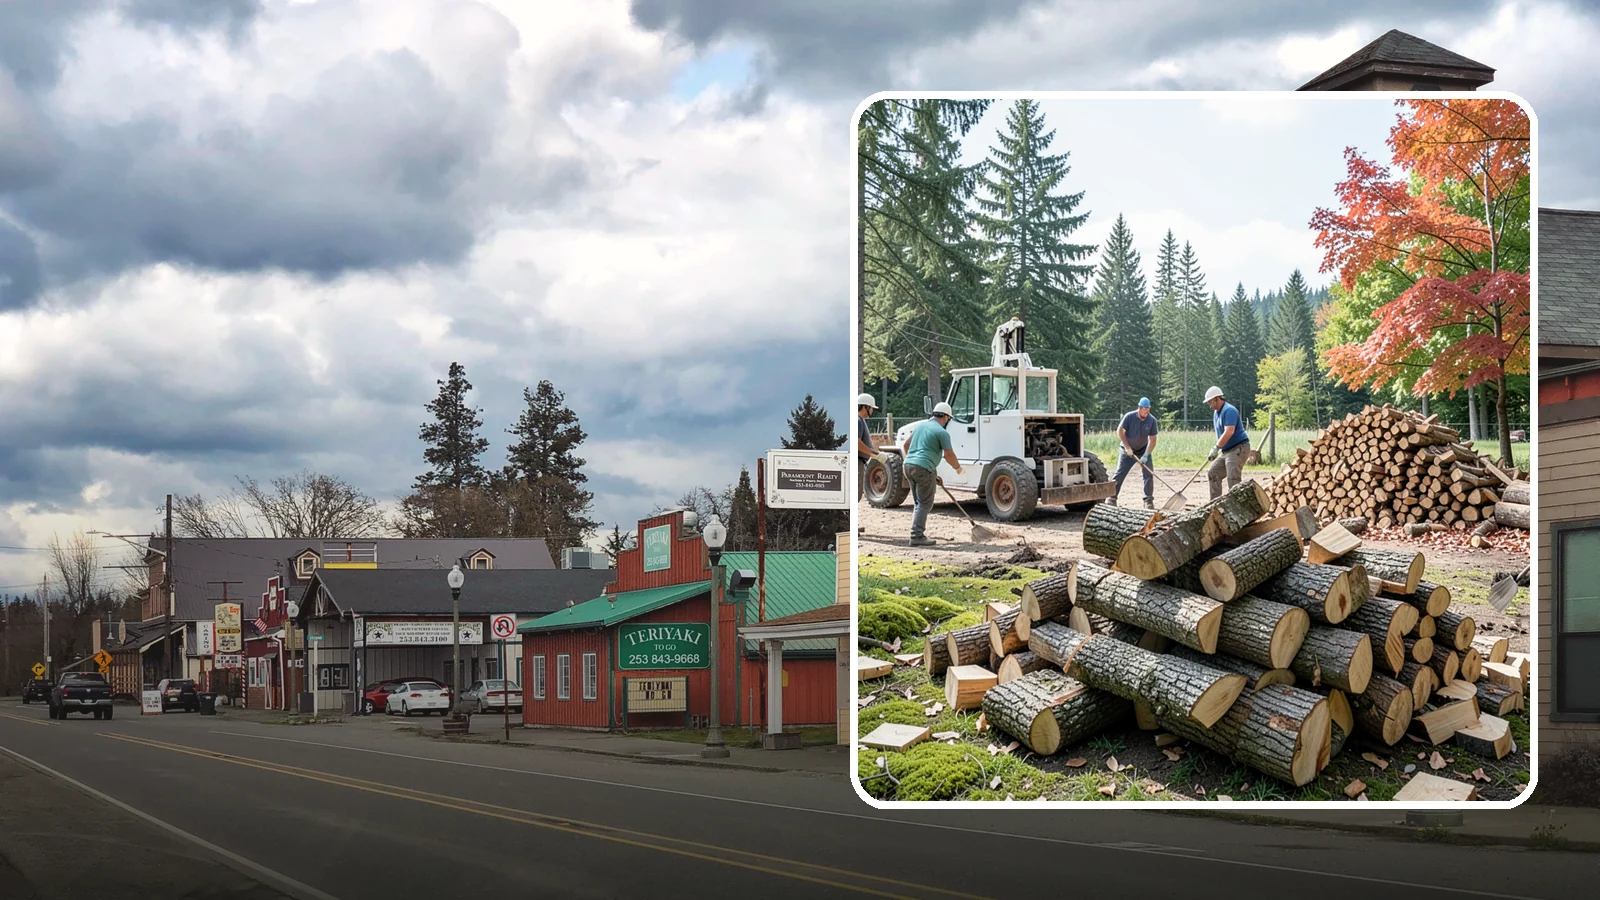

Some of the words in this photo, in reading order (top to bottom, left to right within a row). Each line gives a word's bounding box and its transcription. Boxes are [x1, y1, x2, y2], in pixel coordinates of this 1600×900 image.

[781, 471, 814, 479] PARAMOUNT
[817, 472, 839, 480] REALTY
[624, 627, 702, 646] TERIYAKI
[628, 654, 648, 665] 253
[651, 653, 700, 664] 843-9668
[639, 681, 672, 691] TERIYAKI
